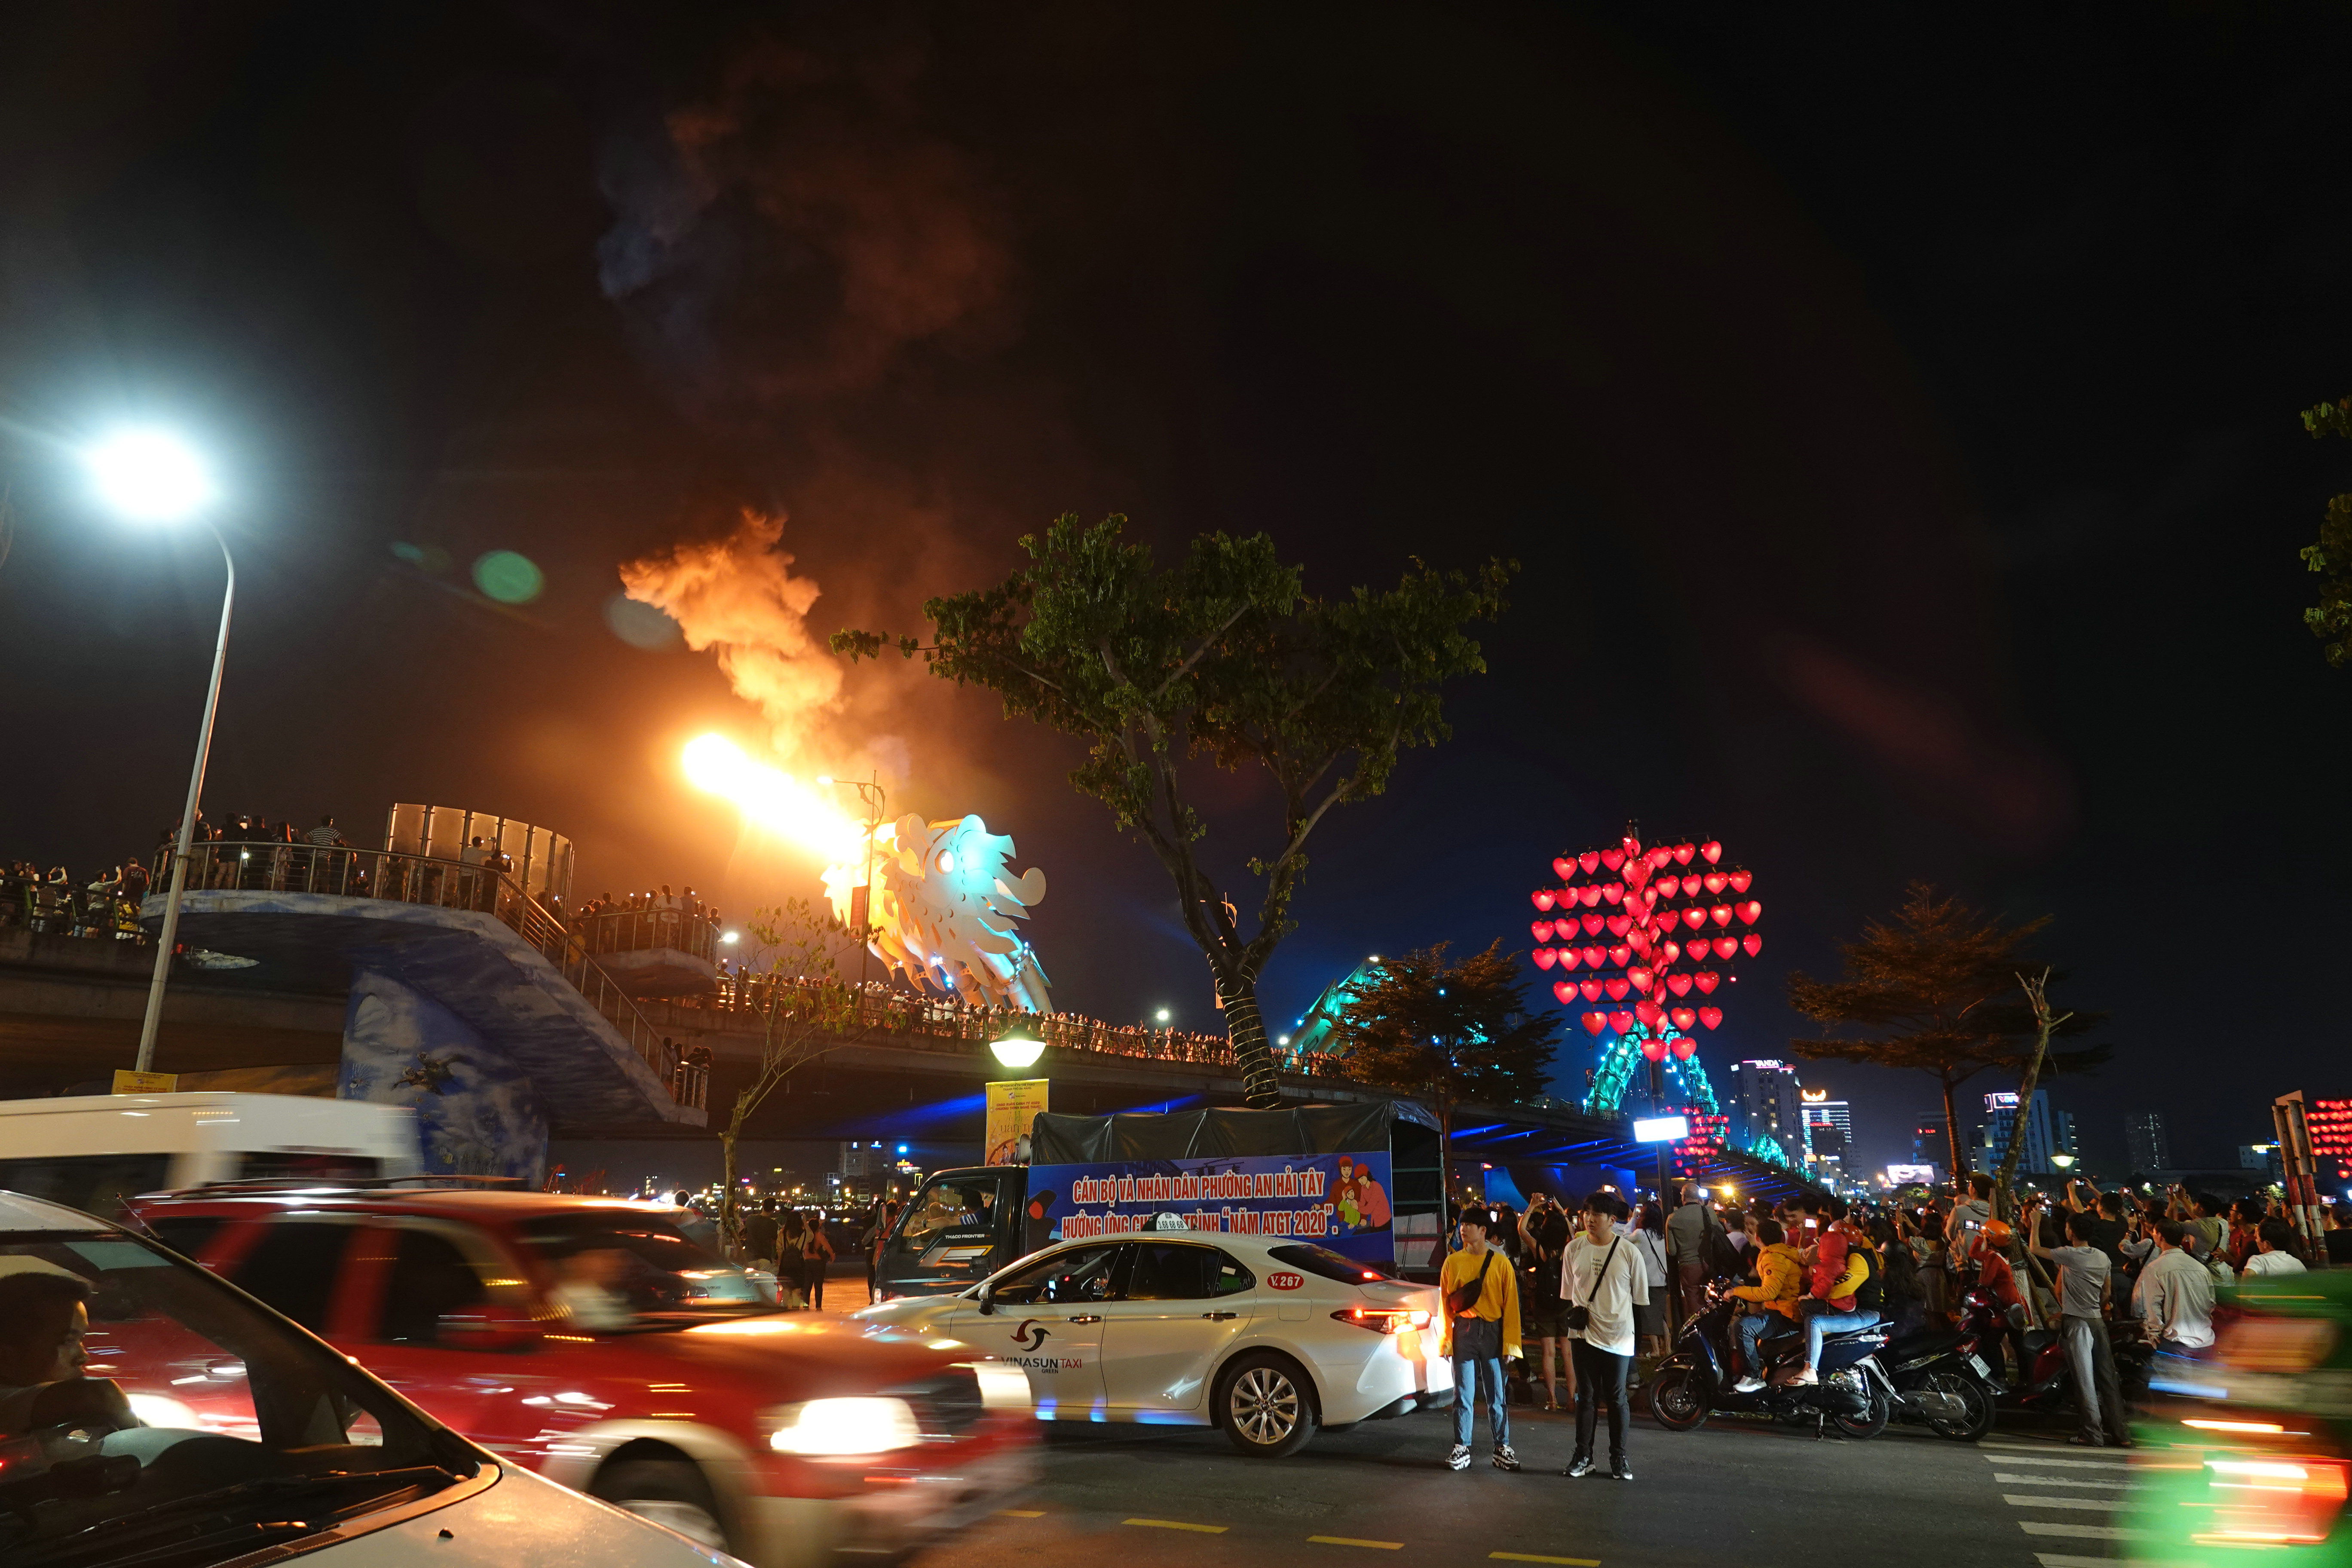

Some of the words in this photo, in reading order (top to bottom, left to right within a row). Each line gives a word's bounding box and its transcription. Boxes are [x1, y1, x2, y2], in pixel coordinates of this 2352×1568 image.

[1074, 1176, 1098, 1203] CÁN
[1100, 1175, 1116, 1206] BỘ
[1118, 1175, 1135, 1201] VÀ
[1137, 1173, 1171, 1200] NHÂN
[1173, 1173, 1199, 1200] DÂN
[1201, 1170, 1252, 1199] PHƯỜNG
[1255, 1174, 1273, 1197] AN
[1276, 1166, 1298, 1196] HẢI
[1299, 1168, 1325, 1196] TÂY
[1062, 1210, 1102, 1238] HƯỞNG
[1104, 1211, 1130, 1234] ỨNG
[1183, 1209, 1220, 1232] TRÌNH
[1262, 1212, 1292, 1235] ATGT
[1169, 1220, 1176, 1228] 68
[1176, 1220, 1184, 1228] 68
[1001, 1357, 1058, 1368] VINASUN
[1060, 1358, 1082, 1369] TAXI
